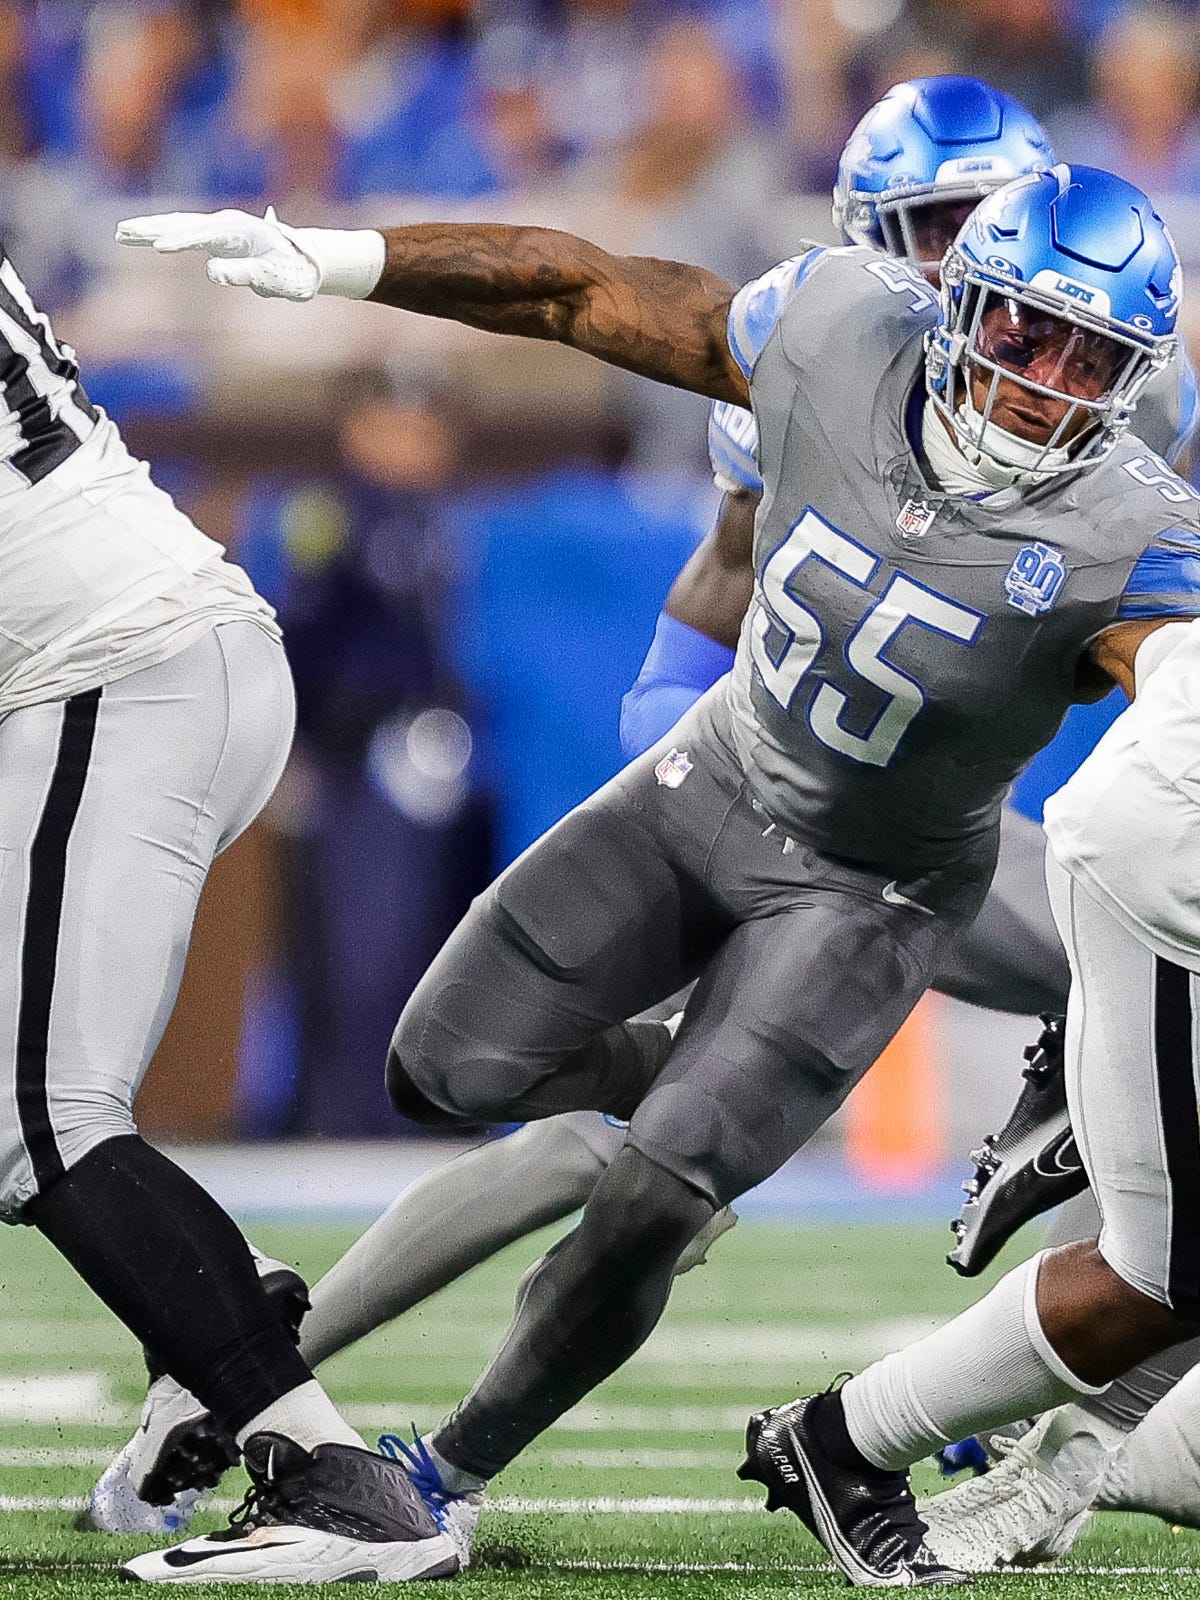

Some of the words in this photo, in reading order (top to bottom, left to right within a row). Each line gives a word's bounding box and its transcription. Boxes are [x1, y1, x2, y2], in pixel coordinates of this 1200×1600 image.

[900, 511, 925, 533] NFL
[1016, 548, 1064, 602] 90
[749, 503, 990, 769] 55
